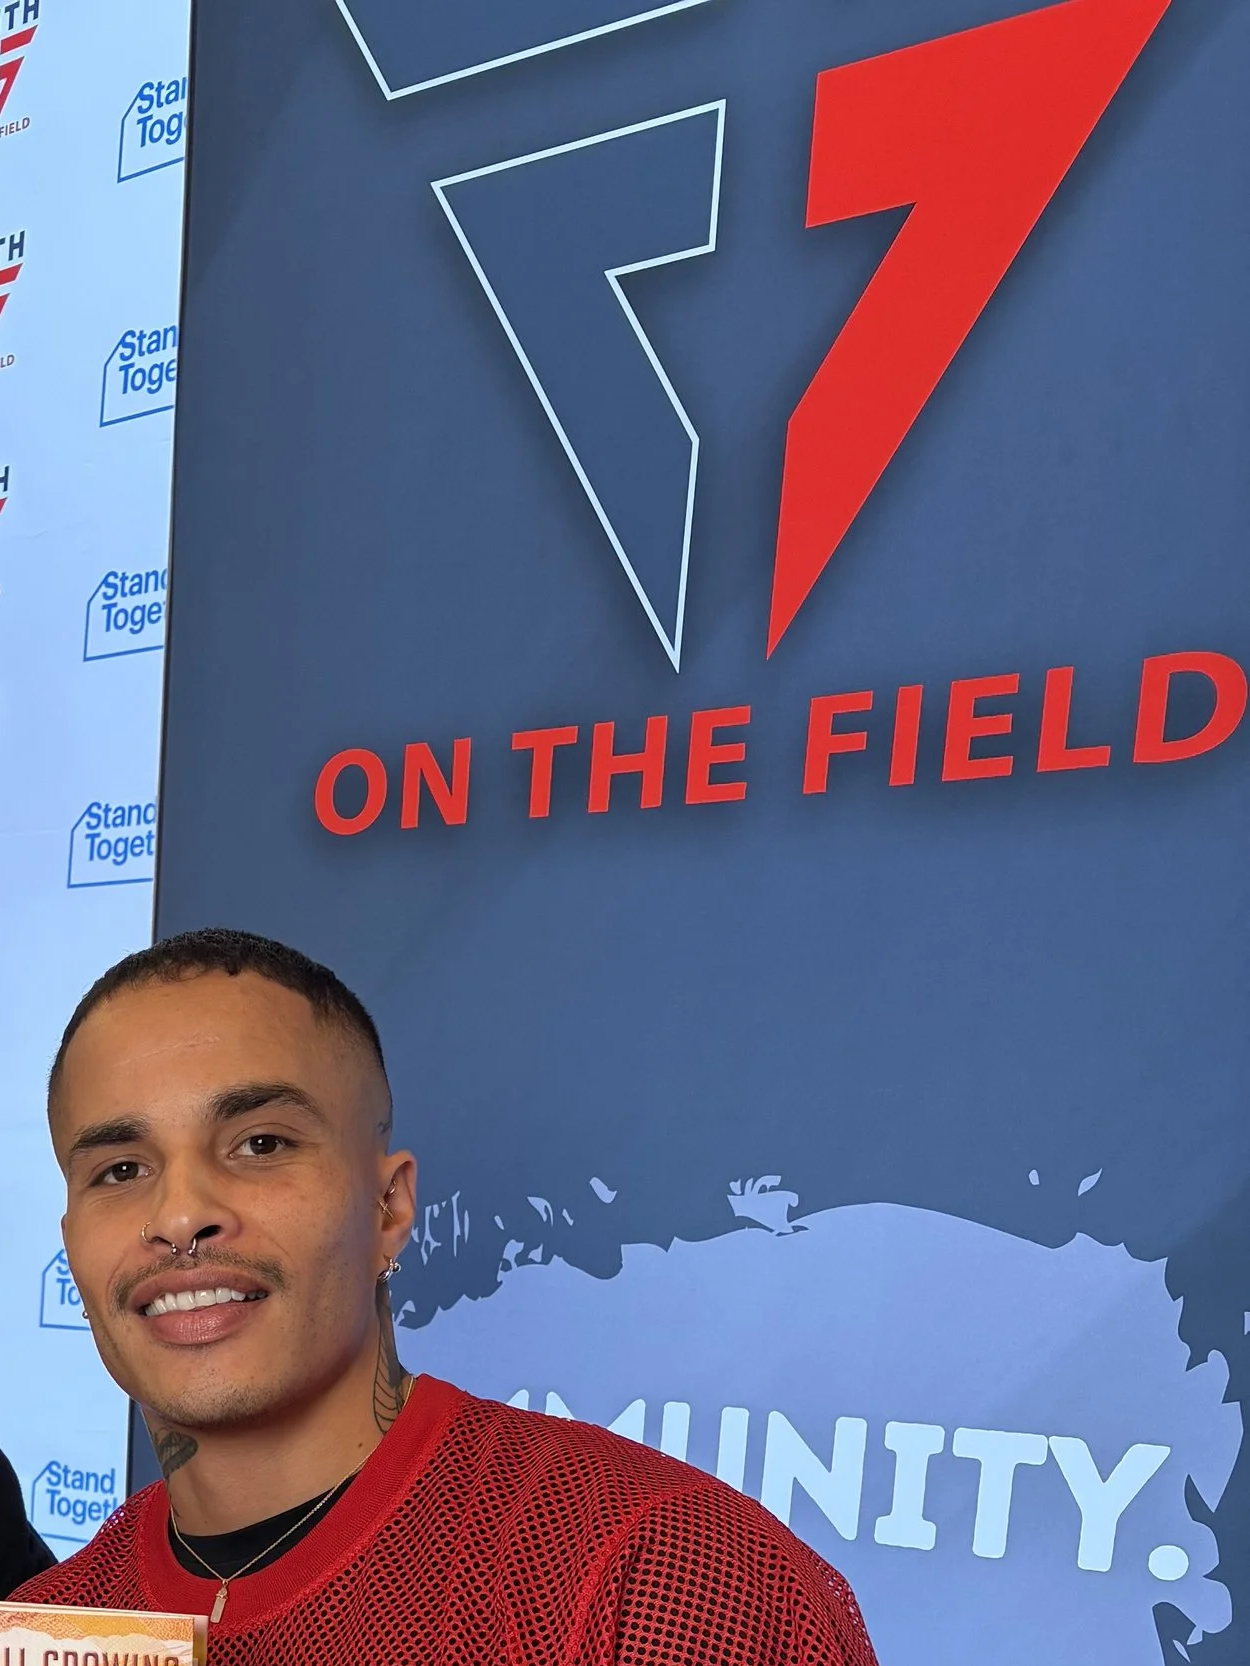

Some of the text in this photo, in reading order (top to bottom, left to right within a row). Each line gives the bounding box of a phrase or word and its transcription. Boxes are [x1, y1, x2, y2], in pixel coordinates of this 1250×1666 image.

[137, 111, 187, 148] Tog
[102, 601, 166, 635] Toge
[314, 651, 1249, 836] ON THE FIELD
[46, 1460, 116, 1494] Stand
